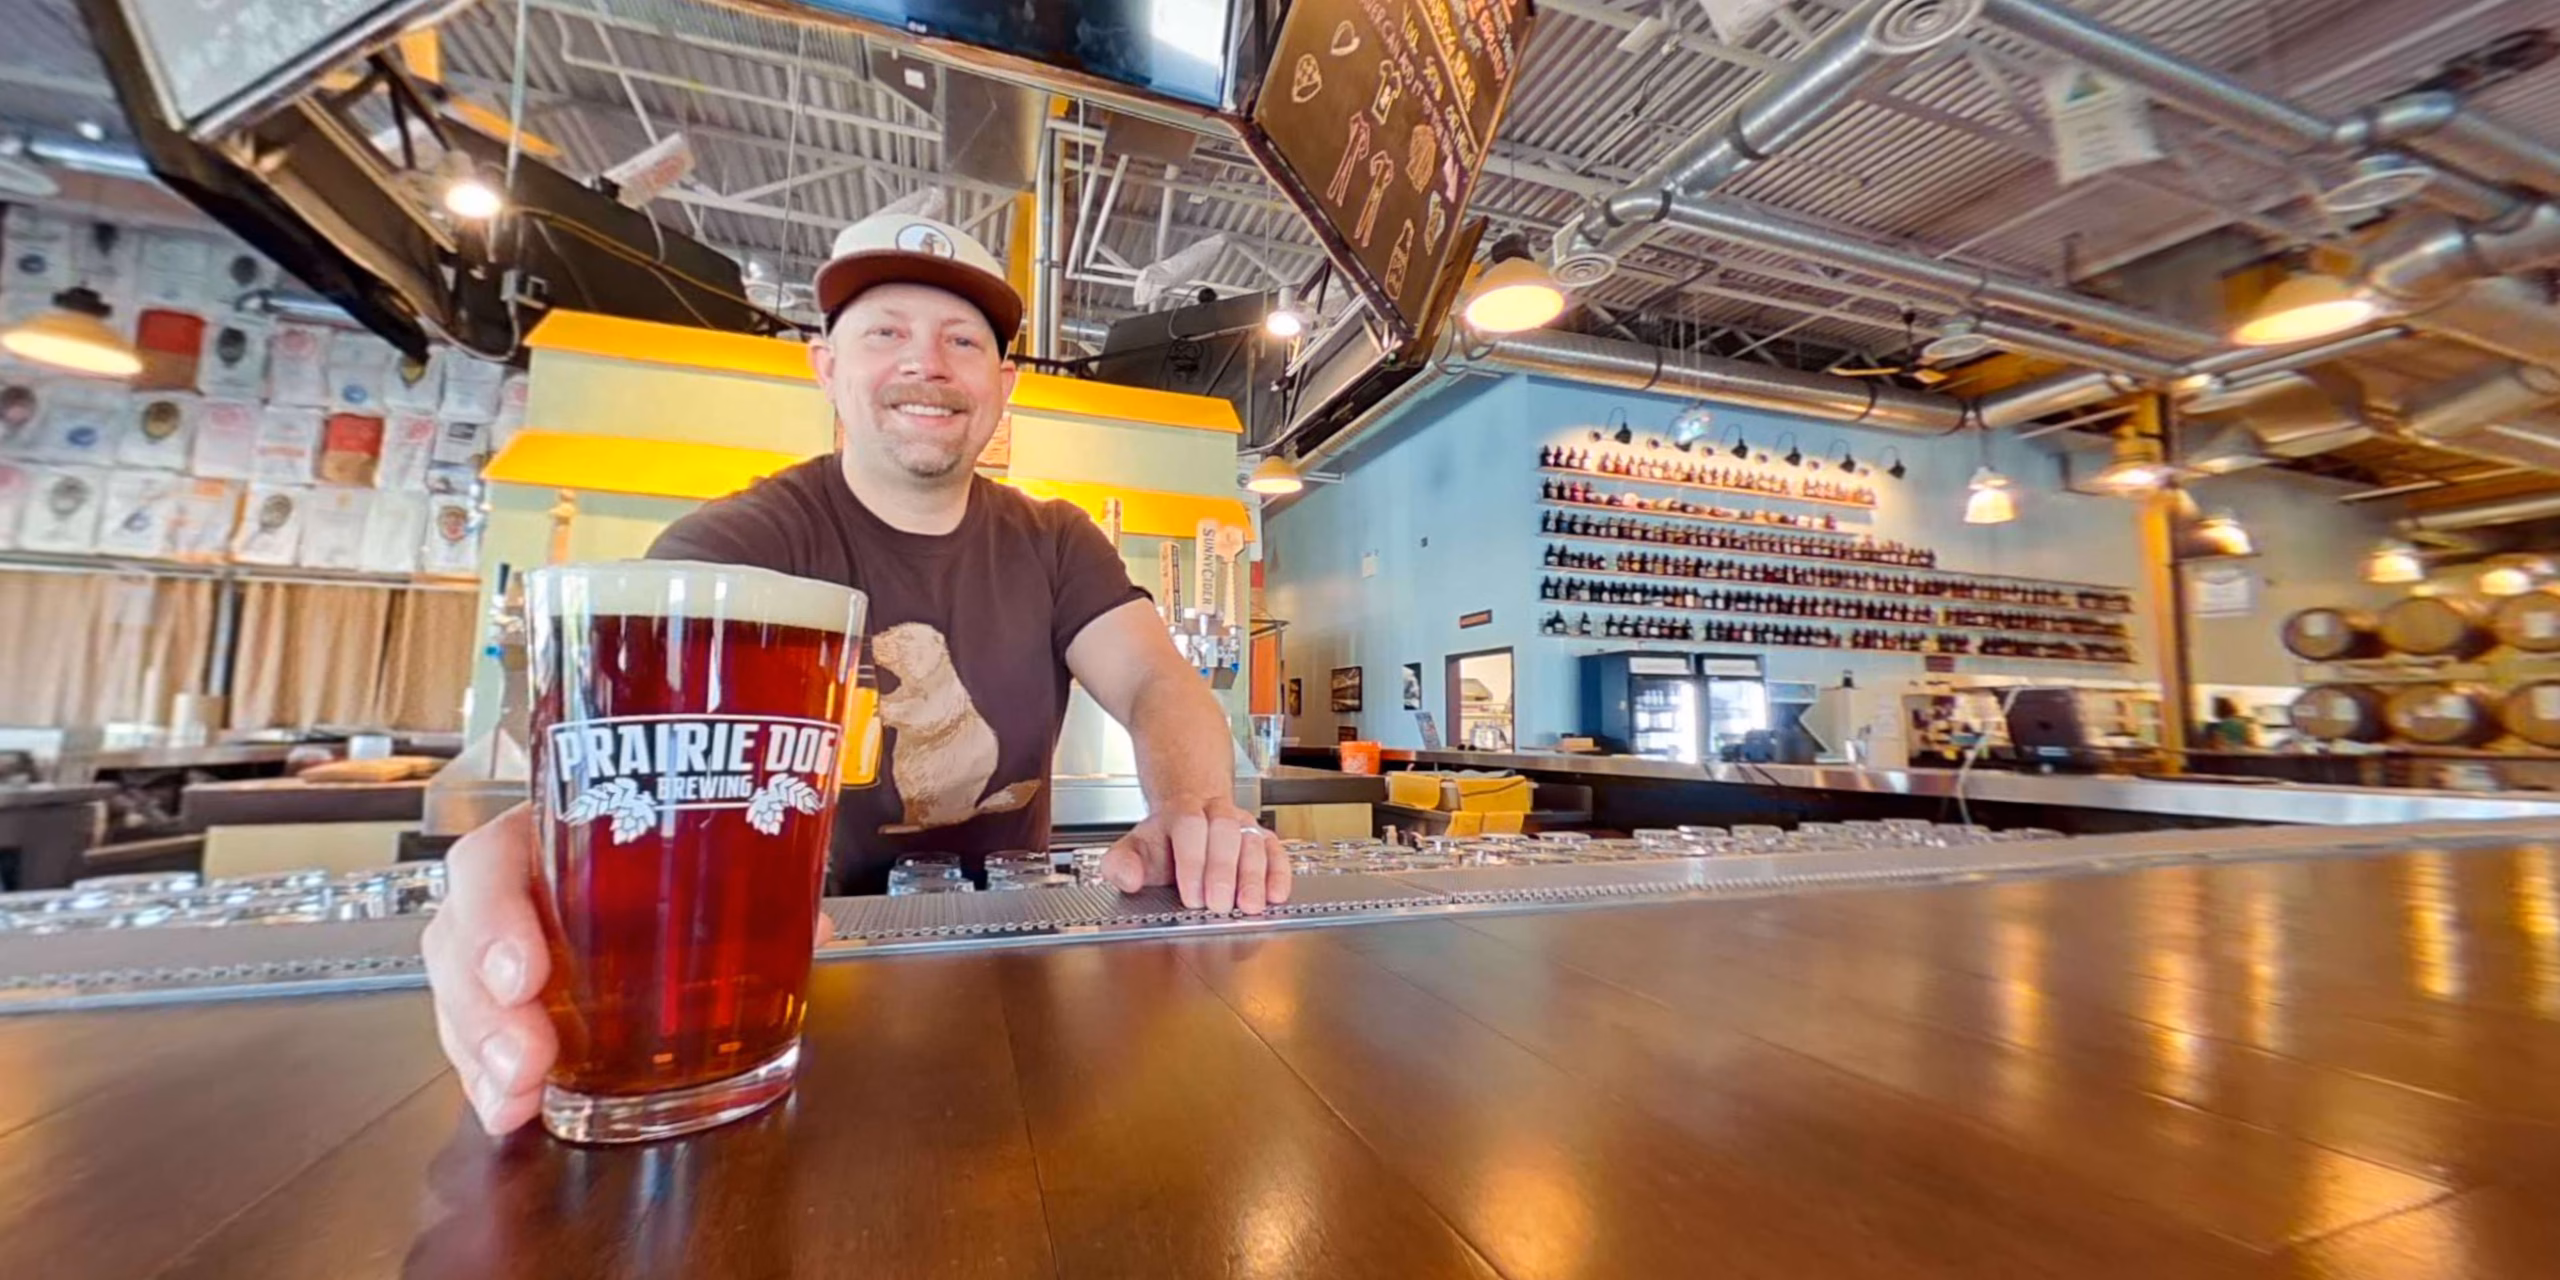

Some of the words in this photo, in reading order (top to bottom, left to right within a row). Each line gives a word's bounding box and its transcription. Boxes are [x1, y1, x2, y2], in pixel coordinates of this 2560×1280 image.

[1202, 527, 1216, 605] SUNNYCIDER
[554, 722, 759, 782] PRAIRIE
[765, 724, 837, 775] DOG
[656, 774, 753, 800] BREWING
